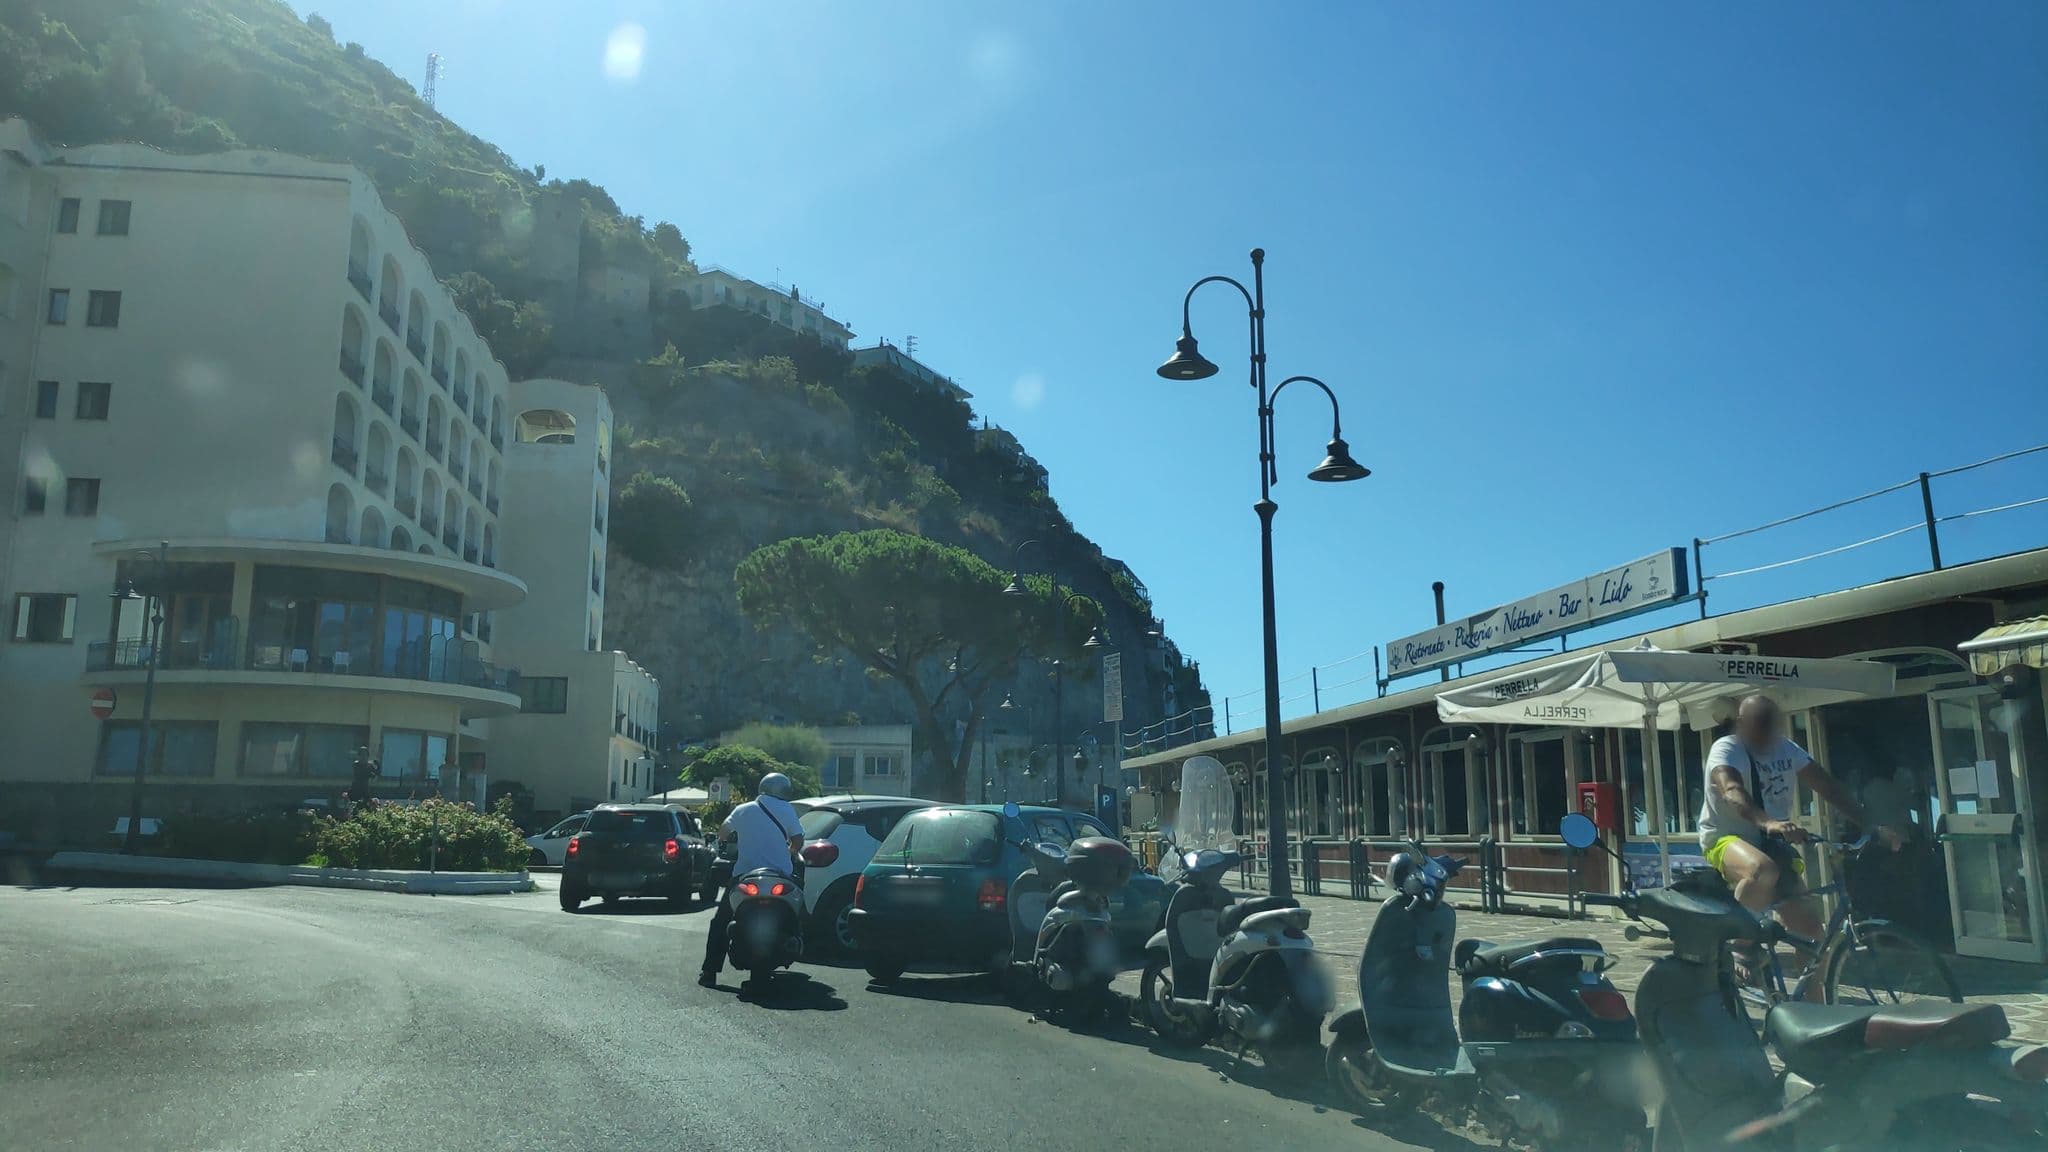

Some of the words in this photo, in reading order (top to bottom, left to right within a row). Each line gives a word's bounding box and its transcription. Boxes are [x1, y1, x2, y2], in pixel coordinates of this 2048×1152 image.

[1404, 636, 1445, 664] Ristorante
[1559, 593, 1581, 618] Bar
[1599, 568, 1632, 605] Lido
[1728, 660, 1799, 678] PERRELLA
[1494, 678, 1539, 698] PERRELLA
[1102, 794, 1110, 807] P
